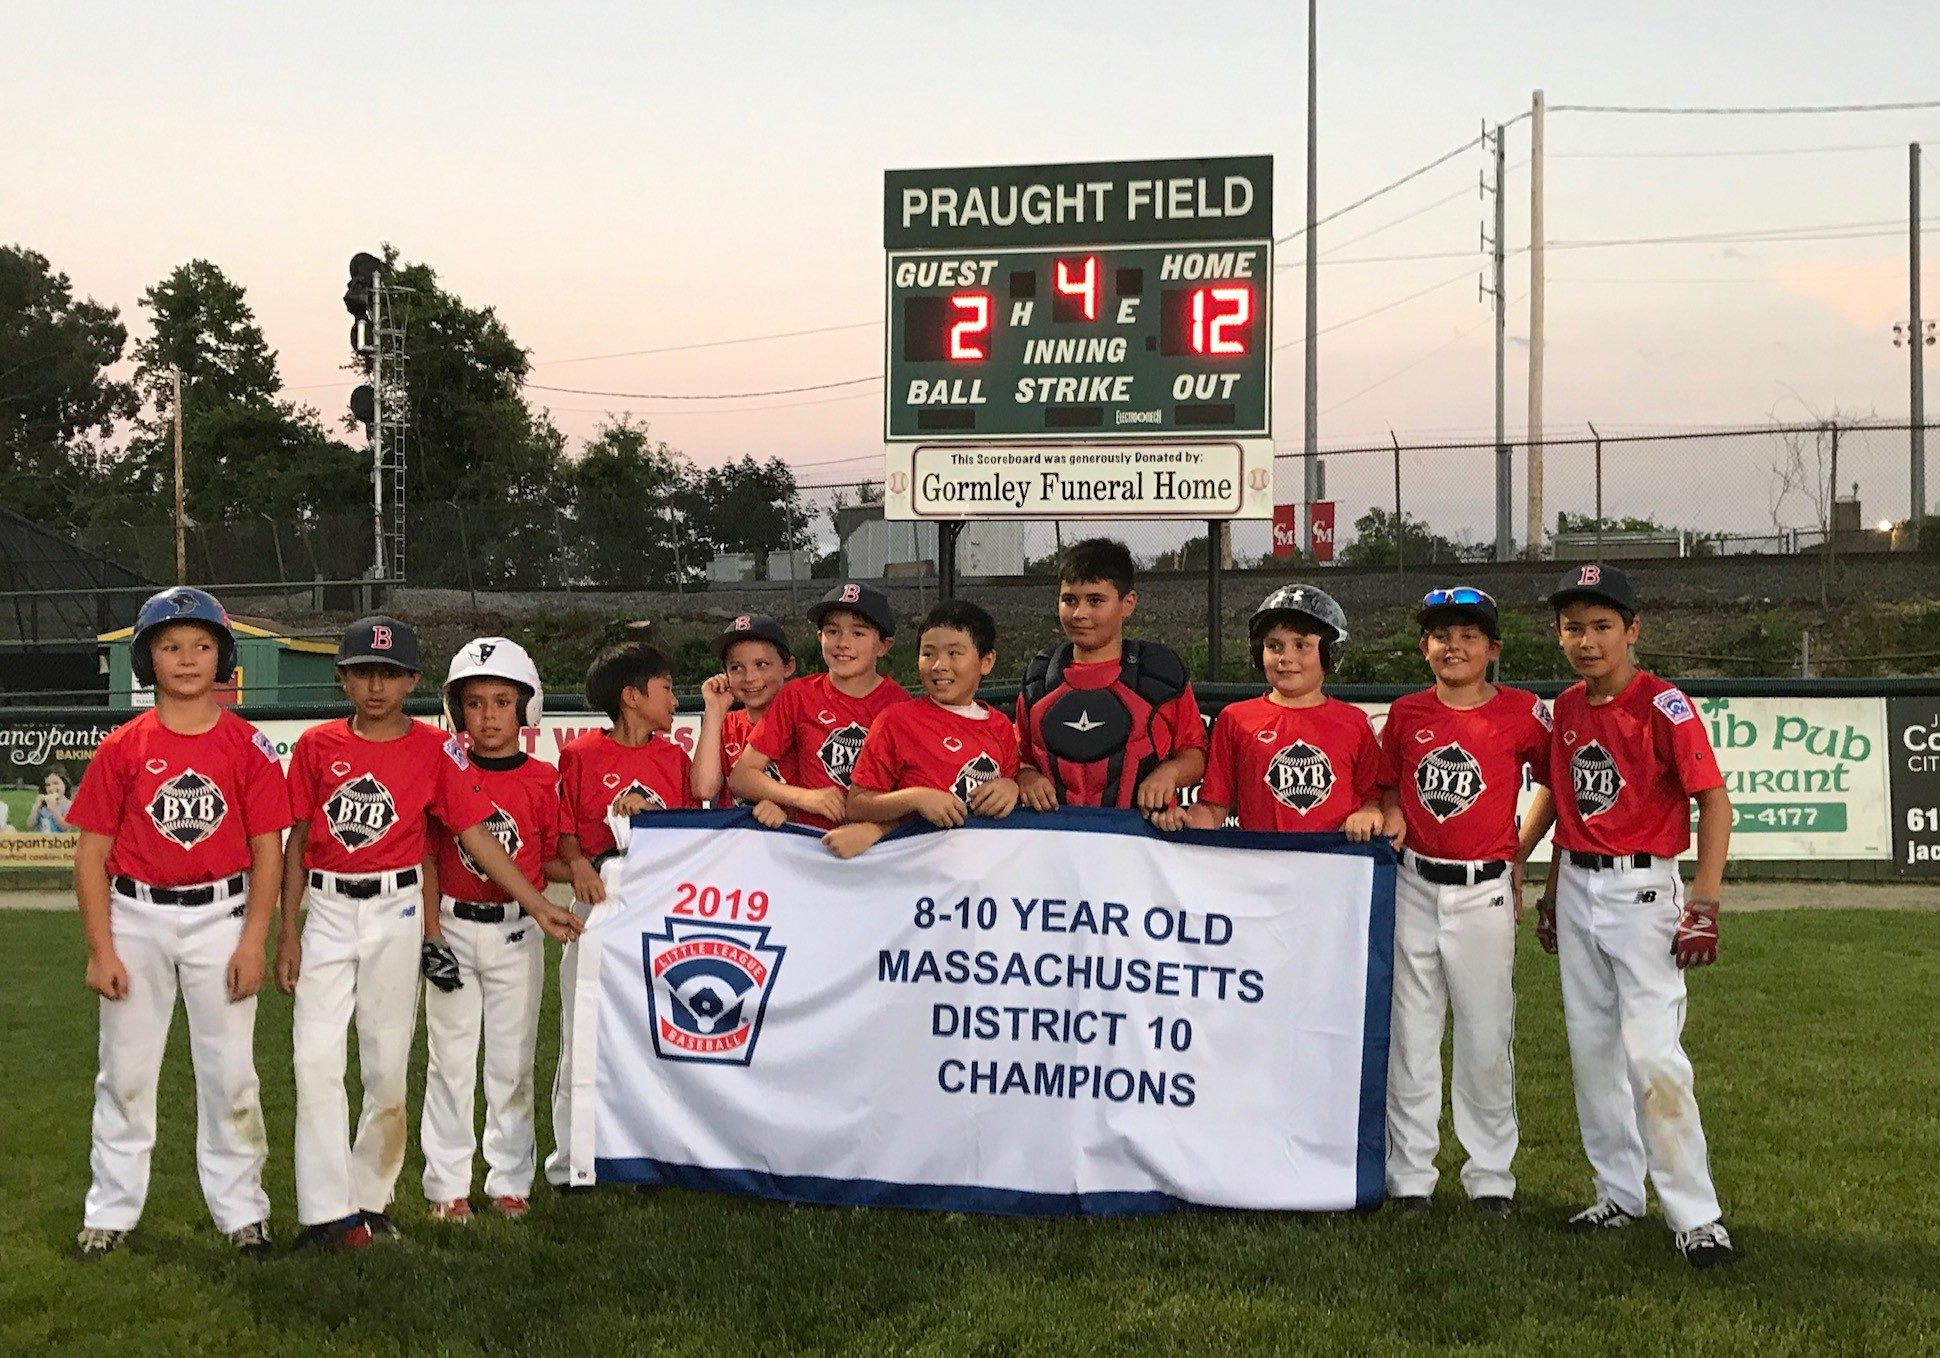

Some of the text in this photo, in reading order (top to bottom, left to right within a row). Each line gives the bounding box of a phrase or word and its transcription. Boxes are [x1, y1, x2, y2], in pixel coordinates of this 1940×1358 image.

[901, 175, 1254, 228] PRAUGHT FIELD
[895, 259, 998, 287] GUEST
[1160, 251, 1257, 281] HOME
[1056, 256, 1096, 321] 4
[1009, 301, 1034, 327] H
[1116, 297, 1141, 324] E
[1191, 288, 1250, 354] 12
[949, 296, 989, 360] 2
[1022, 337, 1127, 365] INNING
[906, 379, 987, 405] BALL
[1014, 376, 1134, 404] STRIKE
[1171, 373, 1242, 401] OUT
[950, 451, 1204, 465] This Scoreboard was generously Donated by:
[921, 470, 1232, 508] Gormley Funeral Home
[1273, 522, 1294, 546] CM
[1312, 520, 1333, 544] CM
[1577, 564, 1601, 586] B
[838, 583, 861, 603] B
[371, 625, 393, 650] B
[734, 615, 751, 631] B
[1772, 714, 1872, 762] Pub
[56, 750, 97, 761] BAKIN
[831, 742, 864, 768] BY
[1277, 762, 1327, 791] BYB
[1422, 762, 1474, 798] BYB
[1572, 765, 1614, 796] BYB
[162, 794, 215, 823] BYB
[335, 795, 386, 830] BYB
[671, 882, 770, 922] 2019
[912, 896, 1234, 947] 8-10 YEAR OLD
[657, 943, 764, 978] LITTLE LEAGUE
[877, 949, 1265, 1004] MASSACHUSETTS
[667, 1030, 743, 1052] BASEBALL
[931, 1002, 1193, 1052] DISTRICT 10
[937, 1058, 1197, 1108] CHAMPIONS
